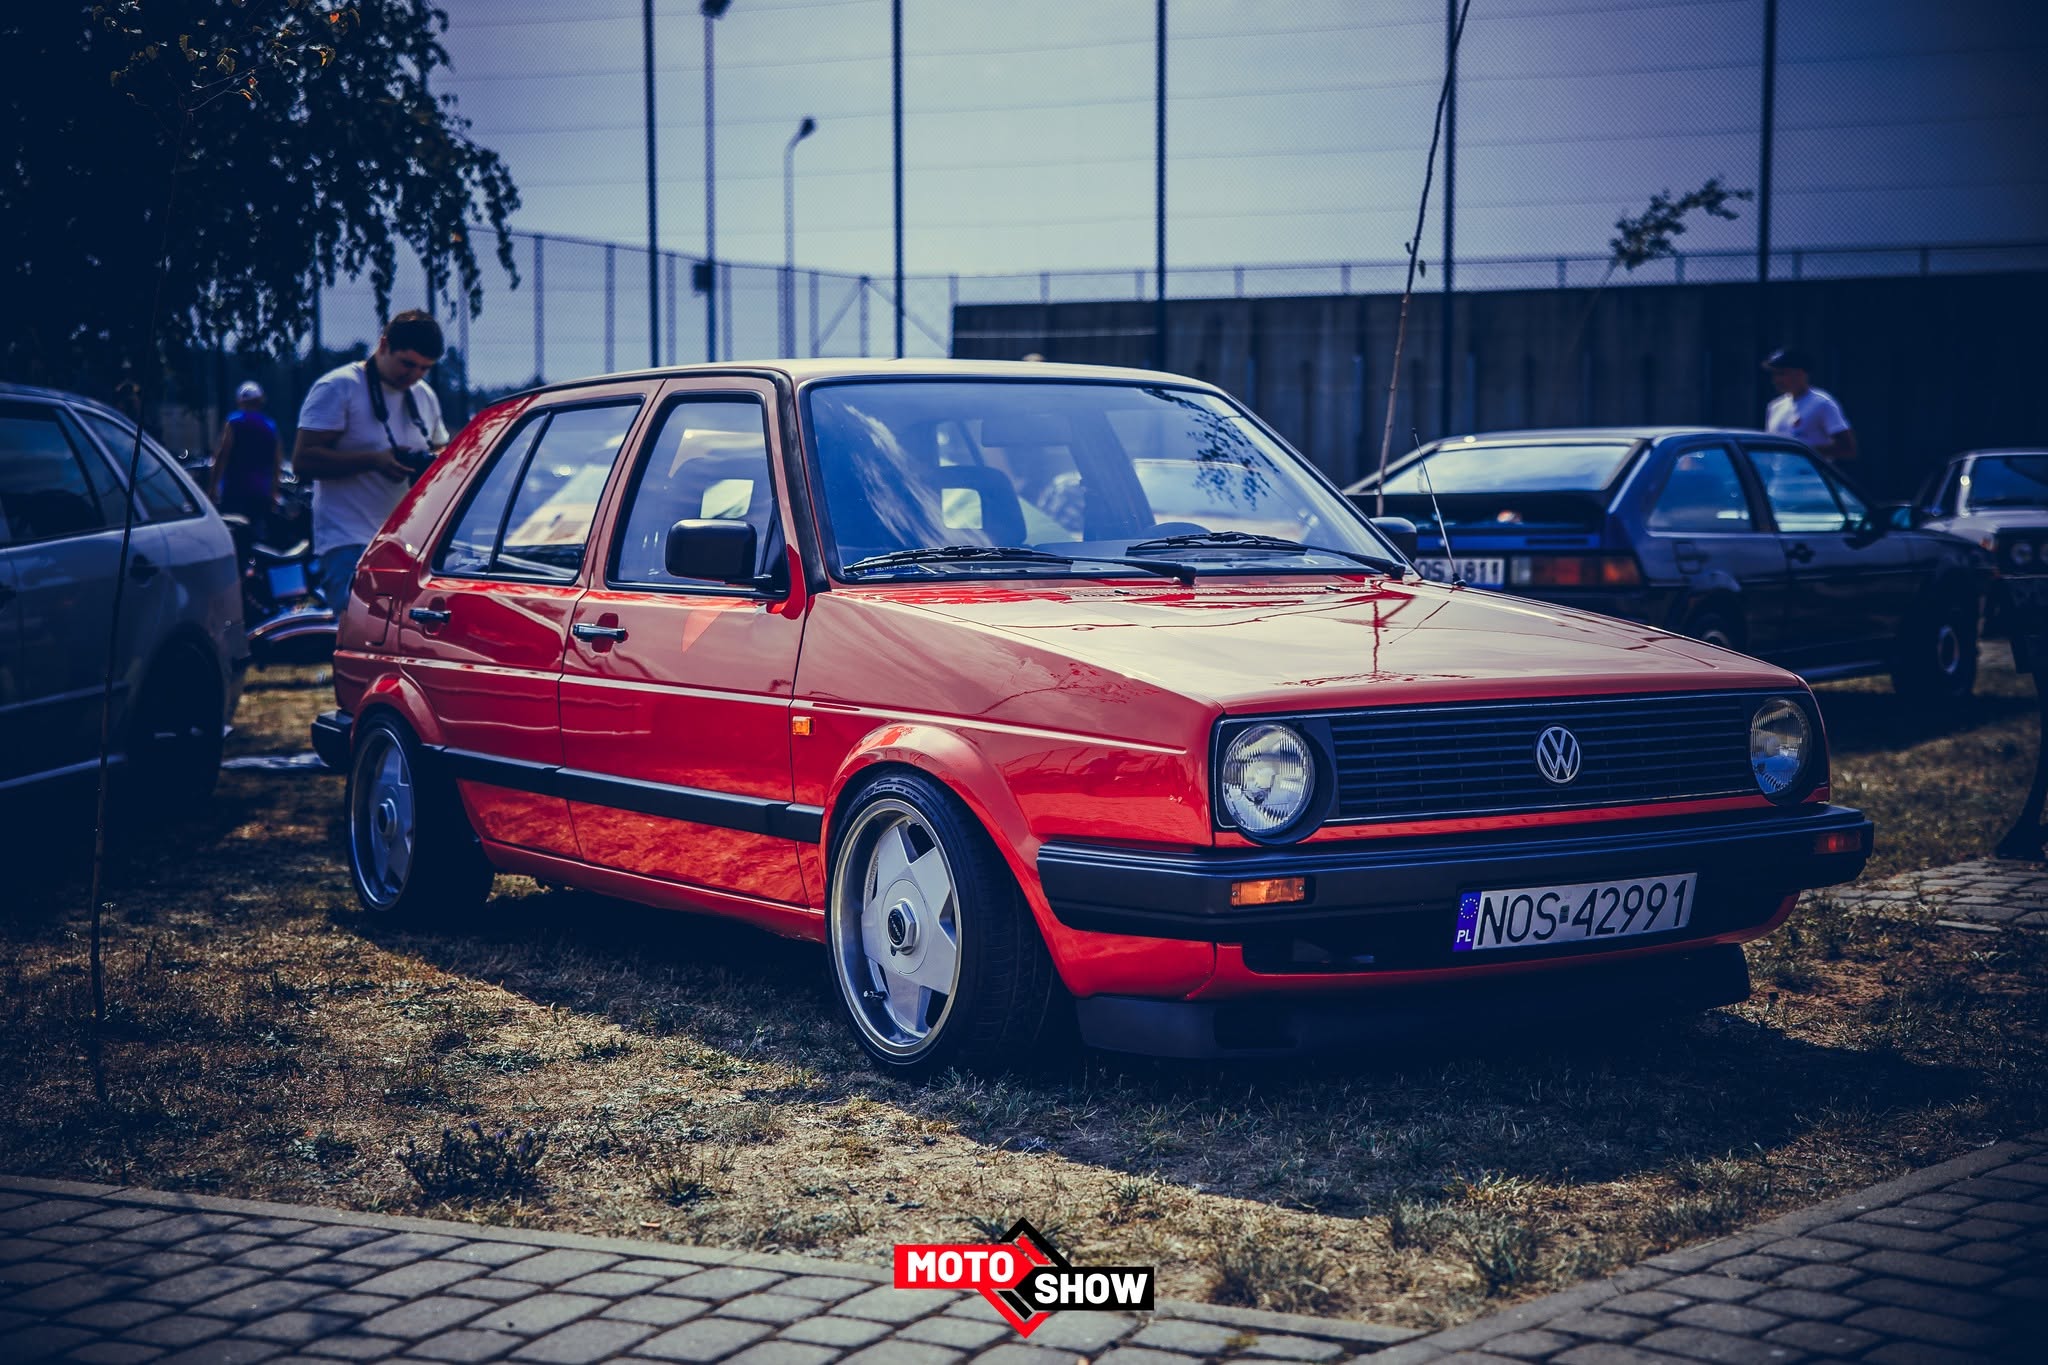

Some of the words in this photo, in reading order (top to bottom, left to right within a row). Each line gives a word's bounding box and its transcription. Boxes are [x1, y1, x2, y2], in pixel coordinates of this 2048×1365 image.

[1537, 727, 1580, 783] VW
[1456, 929, 1472, 943] PL
[1477, 892, 1560, 946] NOS
[1572, 880, 1687, 937] 42991
